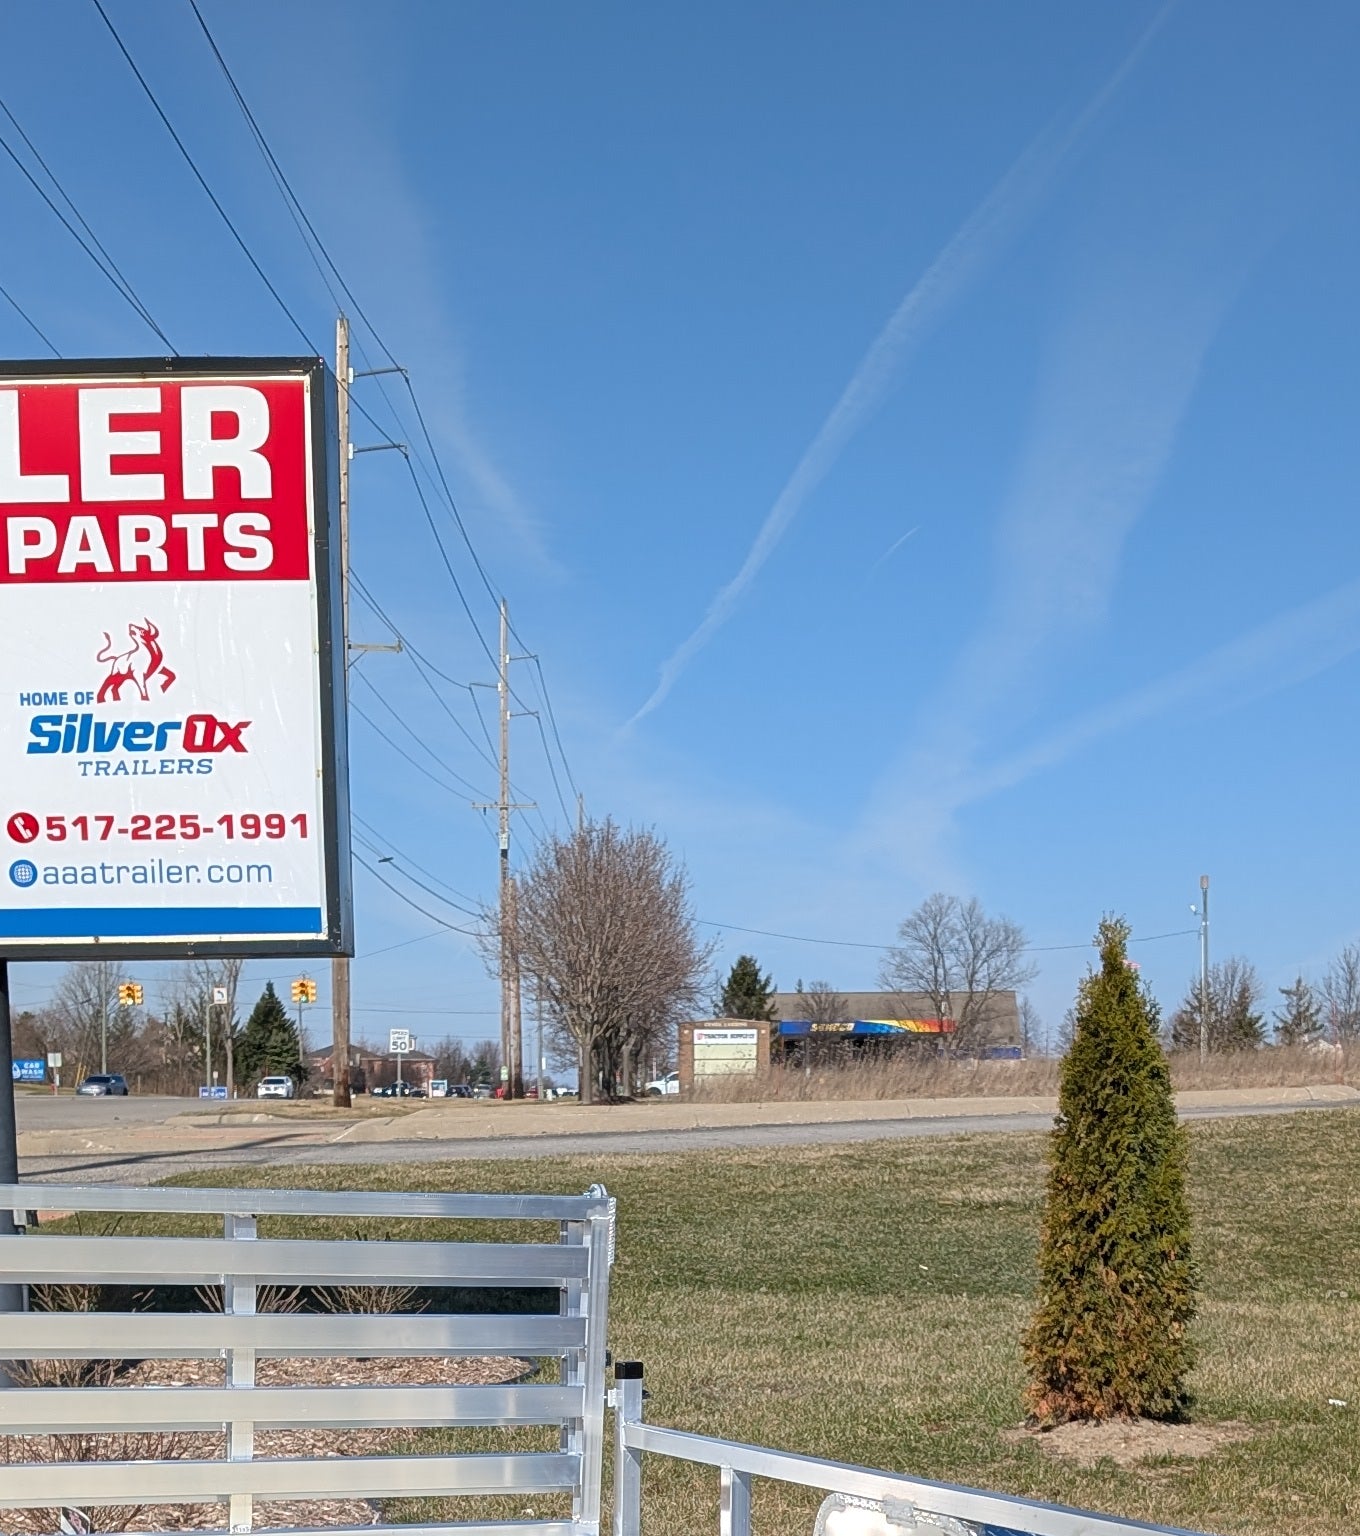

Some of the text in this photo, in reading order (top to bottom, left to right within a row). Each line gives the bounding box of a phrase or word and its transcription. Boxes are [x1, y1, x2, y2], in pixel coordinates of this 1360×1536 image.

[7, 511, 274, 575] PARTS
[19, 690, 94, 707] HOME OF
[25, 713, 253, 755] SilverOx
[77, 758, 214, 777] TRAILERS
[45, 812, 309, 843] 517-225-1991
[42, 857, 272, 887] aaatrailer.com
[392, 1041, 407, 1050] 50
